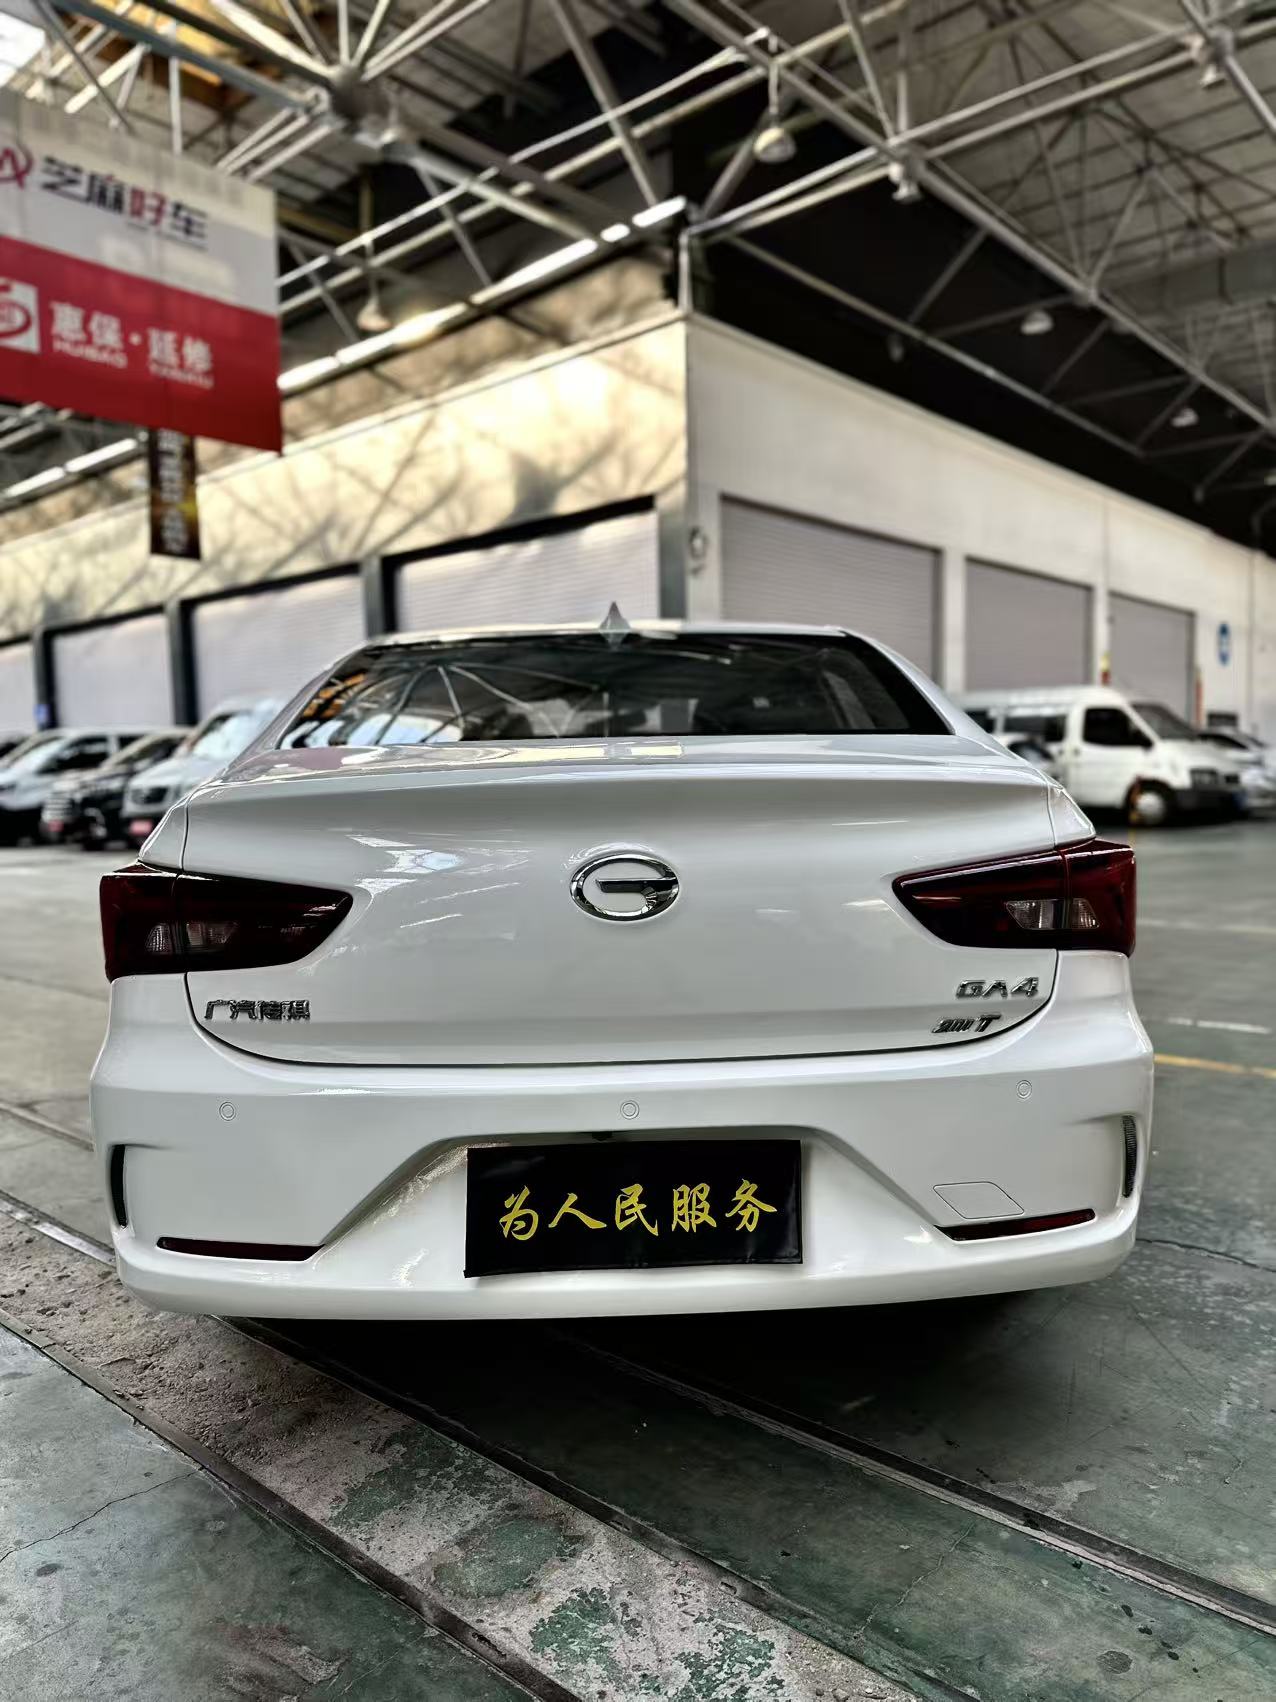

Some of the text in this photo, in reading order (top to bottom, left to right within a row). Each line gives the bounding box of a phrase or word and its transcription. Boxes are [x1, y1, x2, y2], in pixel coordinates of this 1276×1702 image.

[955, 976, 1039, 998] GA4
[499, 1178, 777, 1241] 为人民服务
